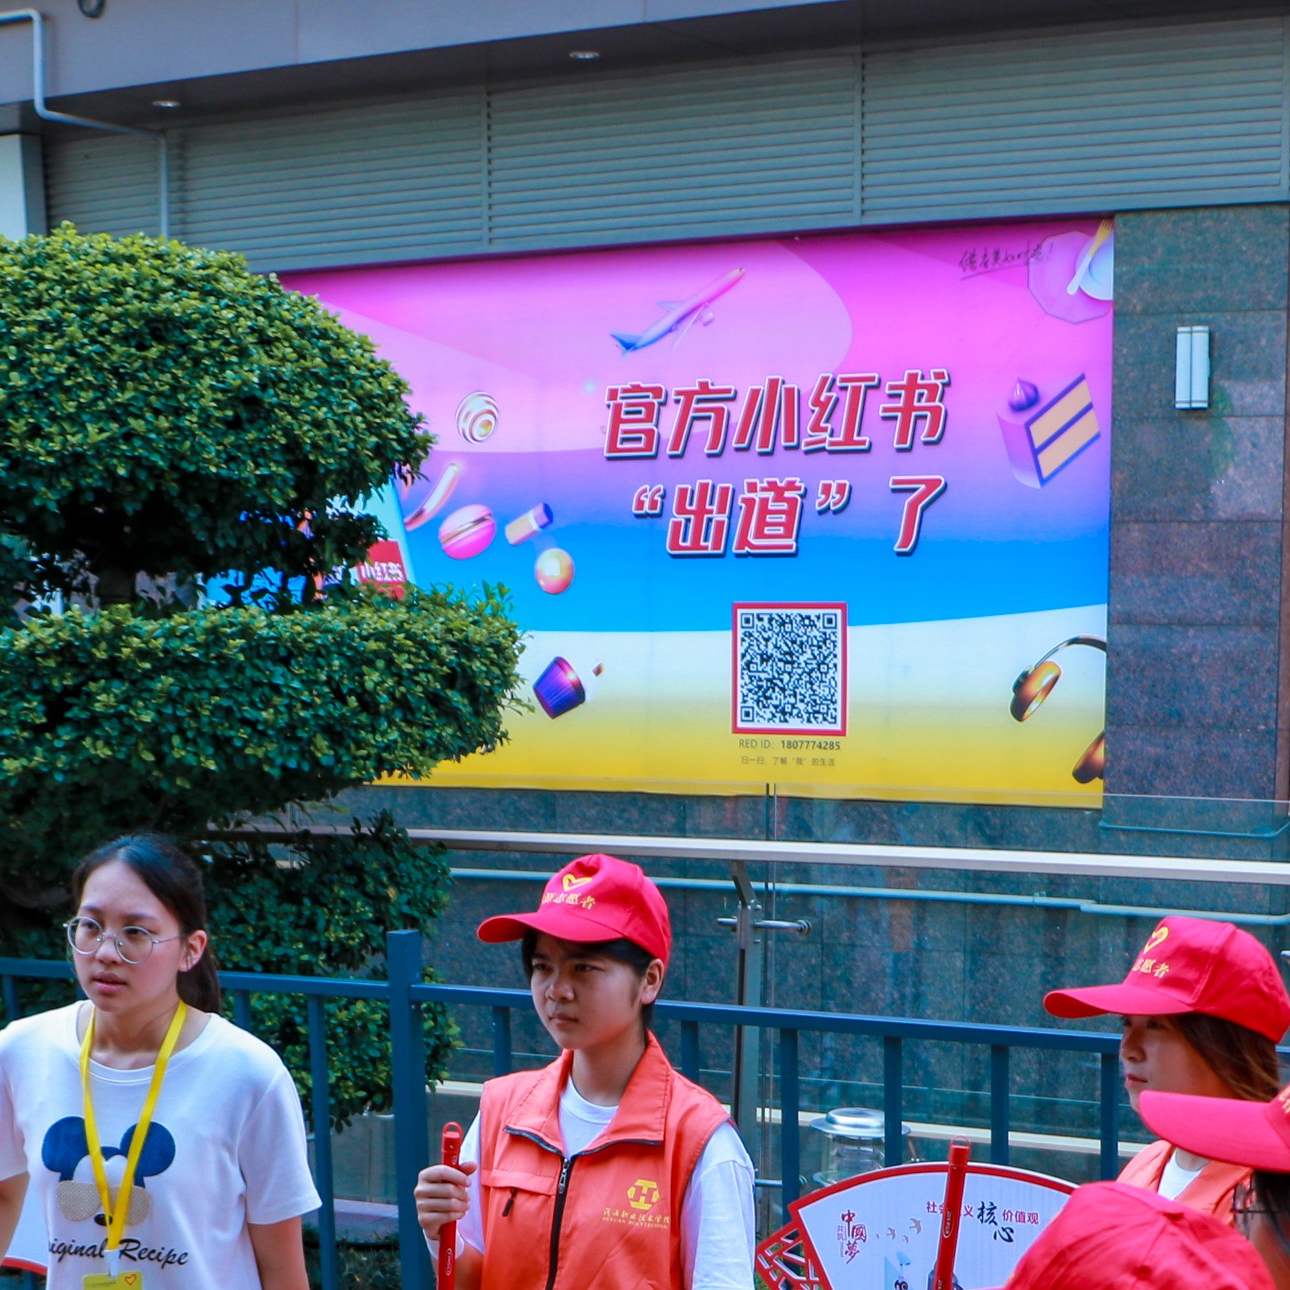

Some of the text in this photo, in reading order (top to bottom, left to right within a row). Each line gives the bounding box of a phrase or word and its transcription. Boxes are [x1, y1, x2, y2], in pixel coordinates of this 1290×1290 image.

[602, 367, 952, 461] 官方小红书
[781, 739, 841, 751] 1807774285
[118, 1238, 189, 1269] Recipe
